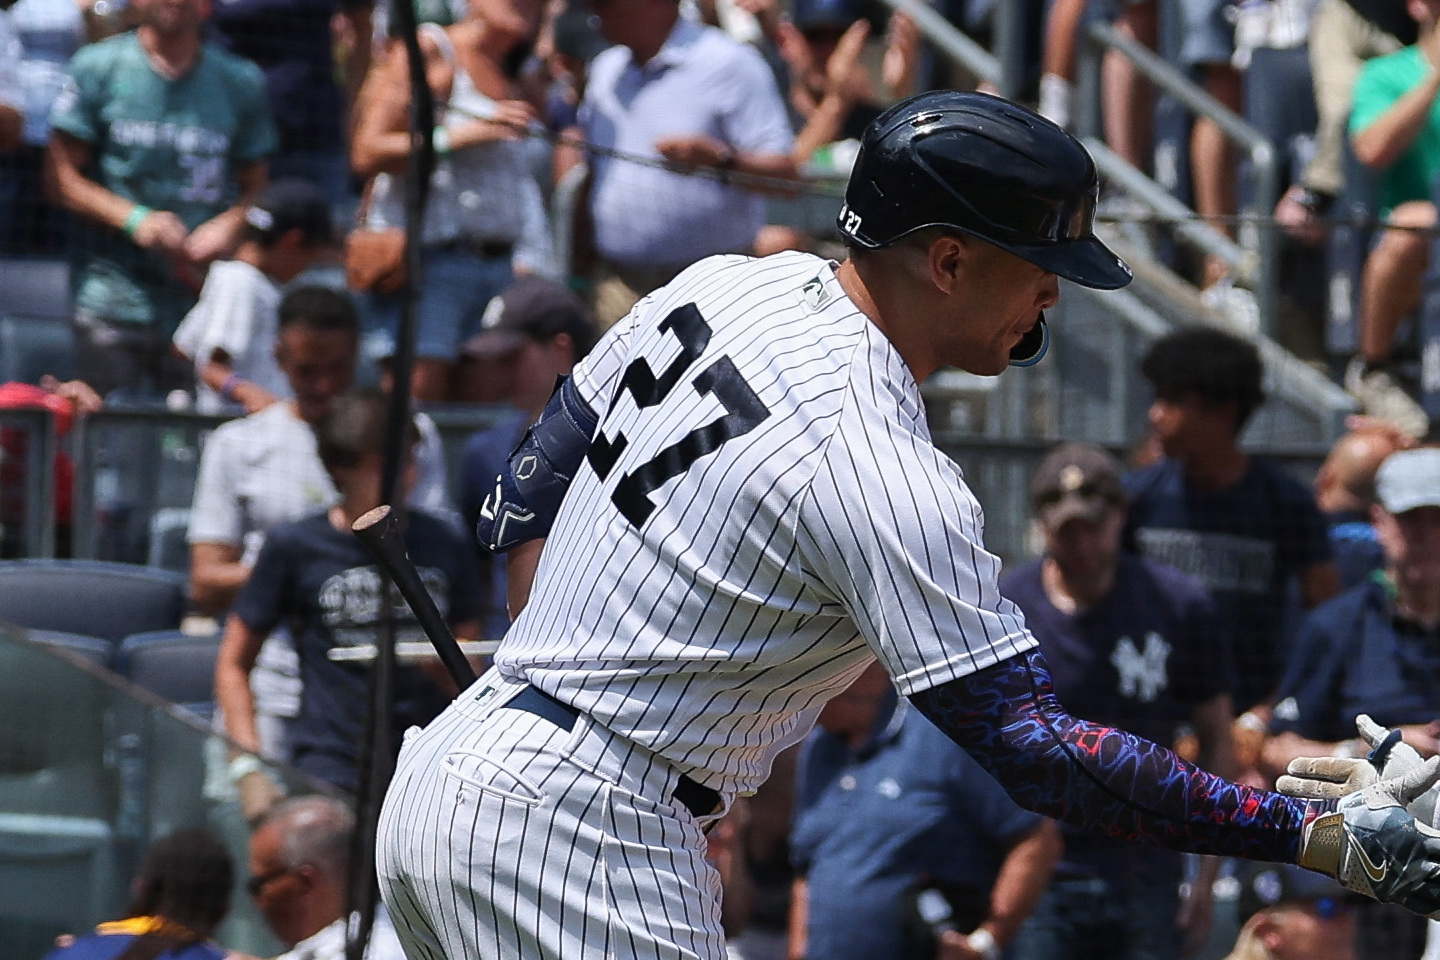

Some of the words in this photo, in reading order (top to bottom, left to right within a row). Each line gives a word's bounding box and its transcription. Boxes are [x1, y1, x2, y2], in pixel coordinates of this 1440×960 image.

[845, 210, 862, 235] 27
[585, 301, 772, 531] 27
[1110, 632, 1172, 700] NY
